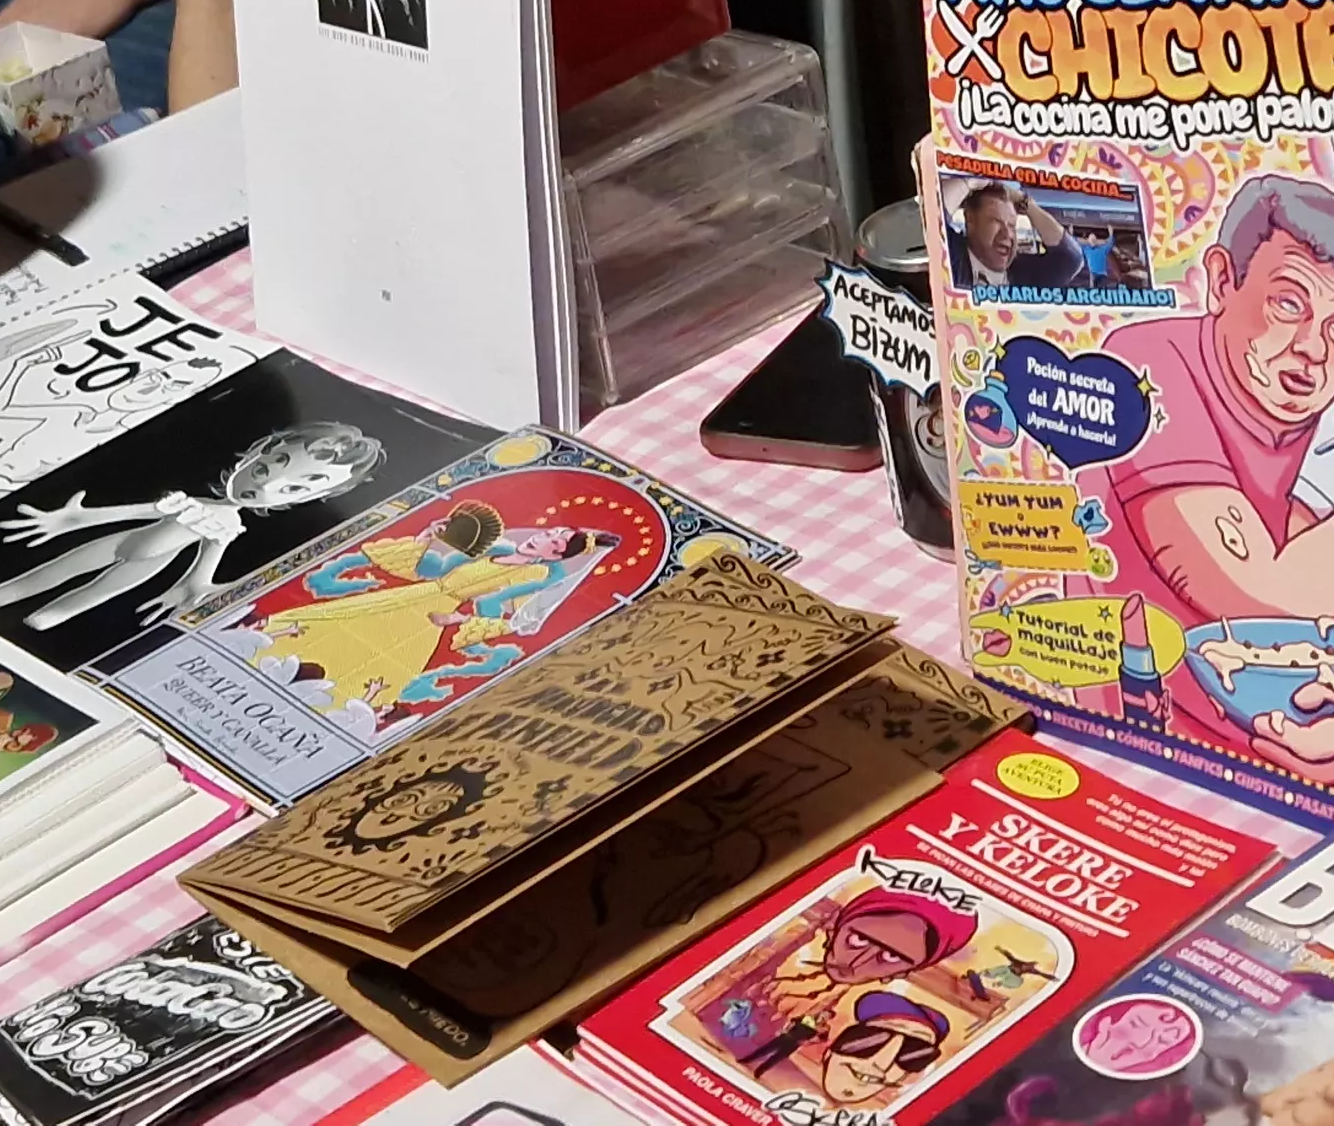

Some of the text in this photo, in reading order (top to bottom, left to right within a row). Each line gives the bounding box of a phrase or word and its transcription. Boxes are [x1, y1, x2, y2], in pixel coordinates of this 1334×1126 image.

[958, 81, 1012, 131] ¡La
[1013, 96, 1113, 138] cocina
[1115, 99, 1169, 141] me
[1170, 97, 1253, 152] pone
[1039, 169, 1059, 188] LA
[832, 273, 936, 340] ACEPTAMOS
[1000, 285, 1064, 306] KARLOS
[98, 296, 224, 362] JE
[1026, 356, 1117, 396] Poción secreta
[1028, 387, 1117, 426] del AMOR
[975, 492, 1064, 511] ¿YUM YUM
[988, 522, 1061, 540] EWWW?
[1016, 610, 1116, 644] Tutorial de
[1017, 627, 1118, 662] maquillaje
[1019, 646, 1110, 677] con buen potaje
[164, 677, 215, 714] QUEER
[176, 655, 248, 706] BEATA
[243, 701, 325, 759] OCAÑA
[938, 812, 1141, 924] Y KELOKE
[990, 812, 1134, 891] SKERE
[681, 1065, 725, 1099] PAOLA
